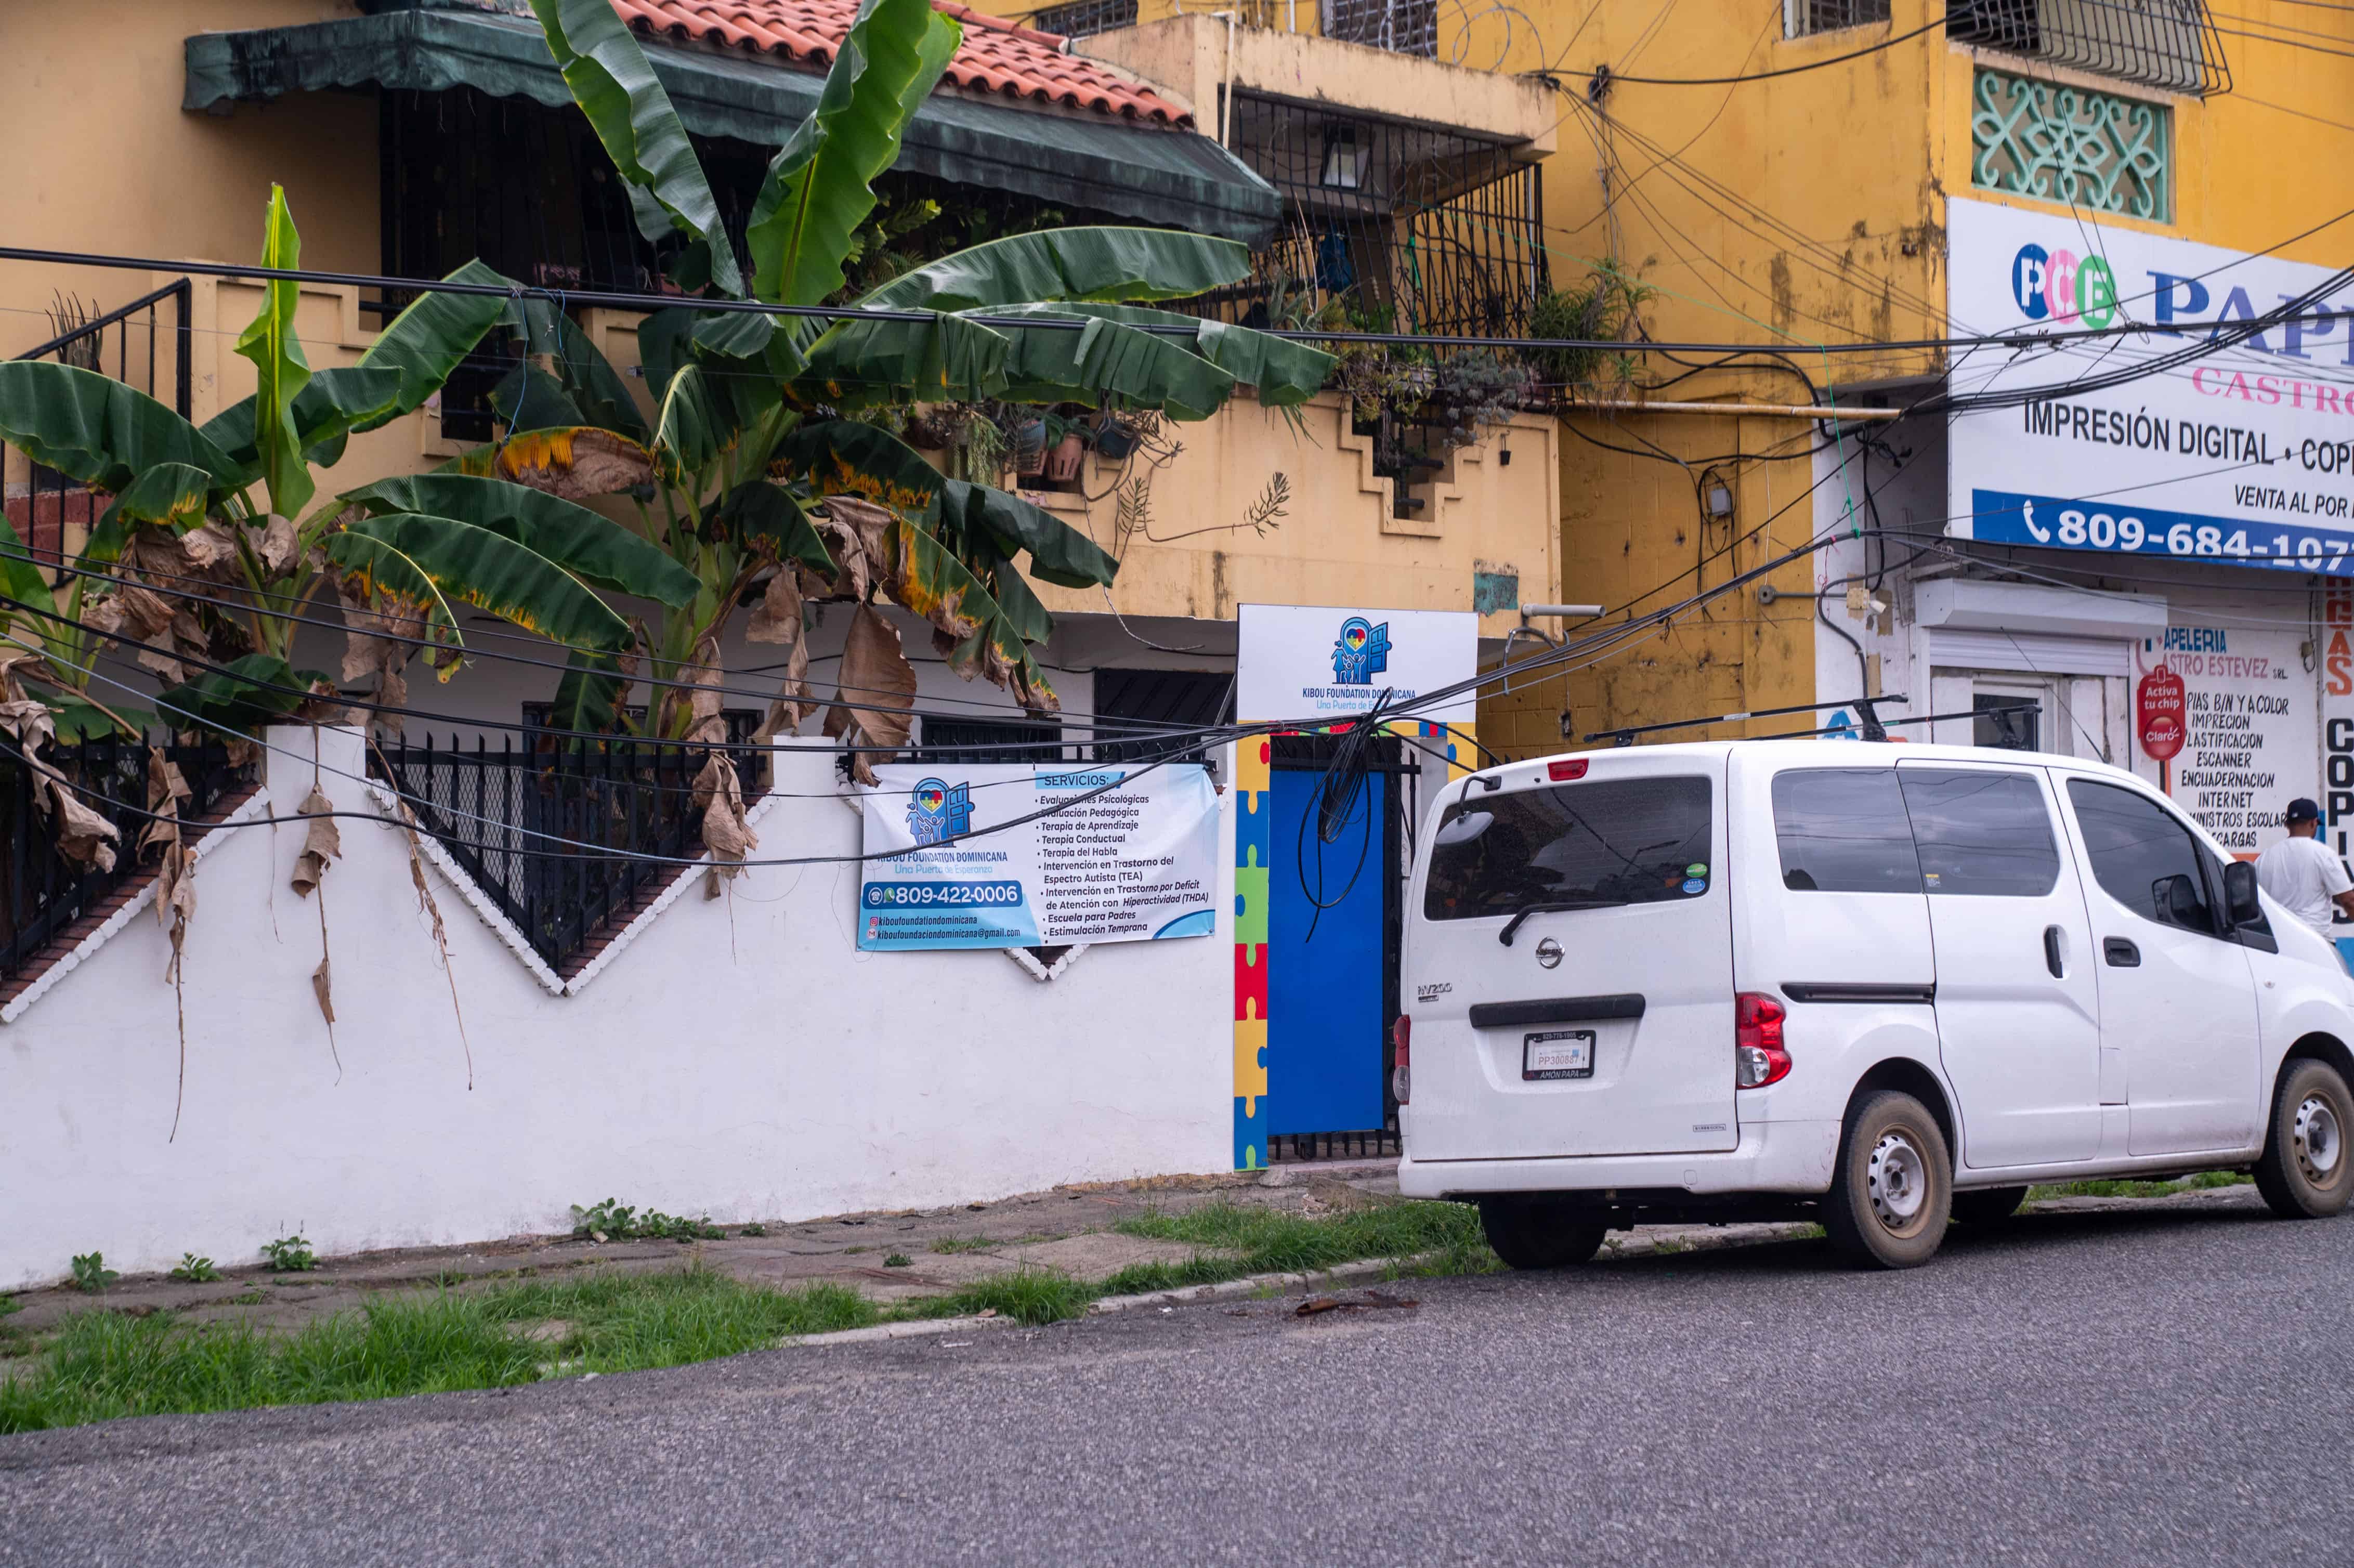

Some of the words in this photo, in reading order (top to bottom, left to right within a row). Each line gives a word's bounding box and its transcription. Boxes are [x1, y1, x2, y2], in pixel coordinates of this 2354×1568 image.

[2146, 270, 2354, 366] PAP
[2024, 398, 2169, 452] IMPRESIÓN
[2179, 421, 2274, 465] DIGITAL
[2235, 484, 2286, 511] VENTA
[2289, 492, 2310, 514] AL
[2314, 494, 2348, 518] POR
[2058, 509, 2354, 574] 809-684-107
[2208, 656, 2269, 678] ESTEVEZ
[1302, 687, 1325, 698] KIBOU
[1326, 688, 1370, 699] FOUNDATION
[1371, 689, 1416, 699] DONICANA
[2146, 686, 2178, 698] Activa
[1316, 700, 1331, 710] Una
[1332, 700, 1356, 710] Puerta
[1357, 701, 1367, 710] de
[2144, 700, 2155, 710] tu
[2157, 697, 2180, 711] chip
[2186, 691, 2209, 711] PIAS
[2214, 691, 2234, 714] B/N
[2237, 694, 2246, 713] Y
[2191, 713, 2250, 730] IMPRECION
[2146, 730, 2175, 742] Claro
[2196, 751, 2252, 769] ESCANNER
[1044, 775, 1109, 786] SERVICIOS:
[2181, 769, 2275, 789] ENCUADERNACION
[1098, 793, 1149, 806] Psicológicas
[2198, 792, 2254, 809] INTERNET
[1089, 806, 1140, 819] Pedagógica
[1041, 821, 1074, 833] Terapia
[1075, 821, 1086, 830] de
[1088, 819, 1139, 832] Aprendizaje
[1042, 834, 1074, 846] Terapia
[1076, 833, 1126, 843] Conductual
[908, 851, 955, 863] FOUNDATION
[956, 851, 1008, 862] DOMINICANA
[1042, 847, 1075, 859] Terapia
[1077, 847, 1090, 856] del
[1092, 846, 1118, 856] Habla
[894, 864, 913, 874] Una
[916, 864, 943, 874] Puerta
[944, 865, 953, 874] de
[954, 864, 993, 875] Esperanza
[1043, 859, 1098, 871] Intervención
[1113, 858, 1158, 869] Trastorno
[1160, 856, 1174, 866] del
[1044, 874, 1082, 885] Espectro
[1084, 872, 1116, 883] Autista
[1118, 871, 1143, 883] (TEA)
[895, 885, 1018, 904] 809-422-0006
[1045, 886, 1101, 897] Intervención
[1103, 887, 1115, 895] en
[1117, 884, 1159, 894] Trastorno
[1159, 883, 1173, 893] por
[1045, 900, 1057, 910] de
[1059, 898, 1100, 910] Atención
[1122, 894, 1181, 908] Hiperactividad
[1182, 892, 1209, 905] (THDA)
[878, 915, 978, 926] kiboufoundationdominicana
[1048, 913, 1083, 923] Escuela
[1084, 914, 1106, 924] para
[1107, 910, 1136, 921] Padres
[1049, 925, 1106, 936] Estimulación
[1107, 923, 1148, 934] Temprana
[1417, 982, 1453, 996] NV200
